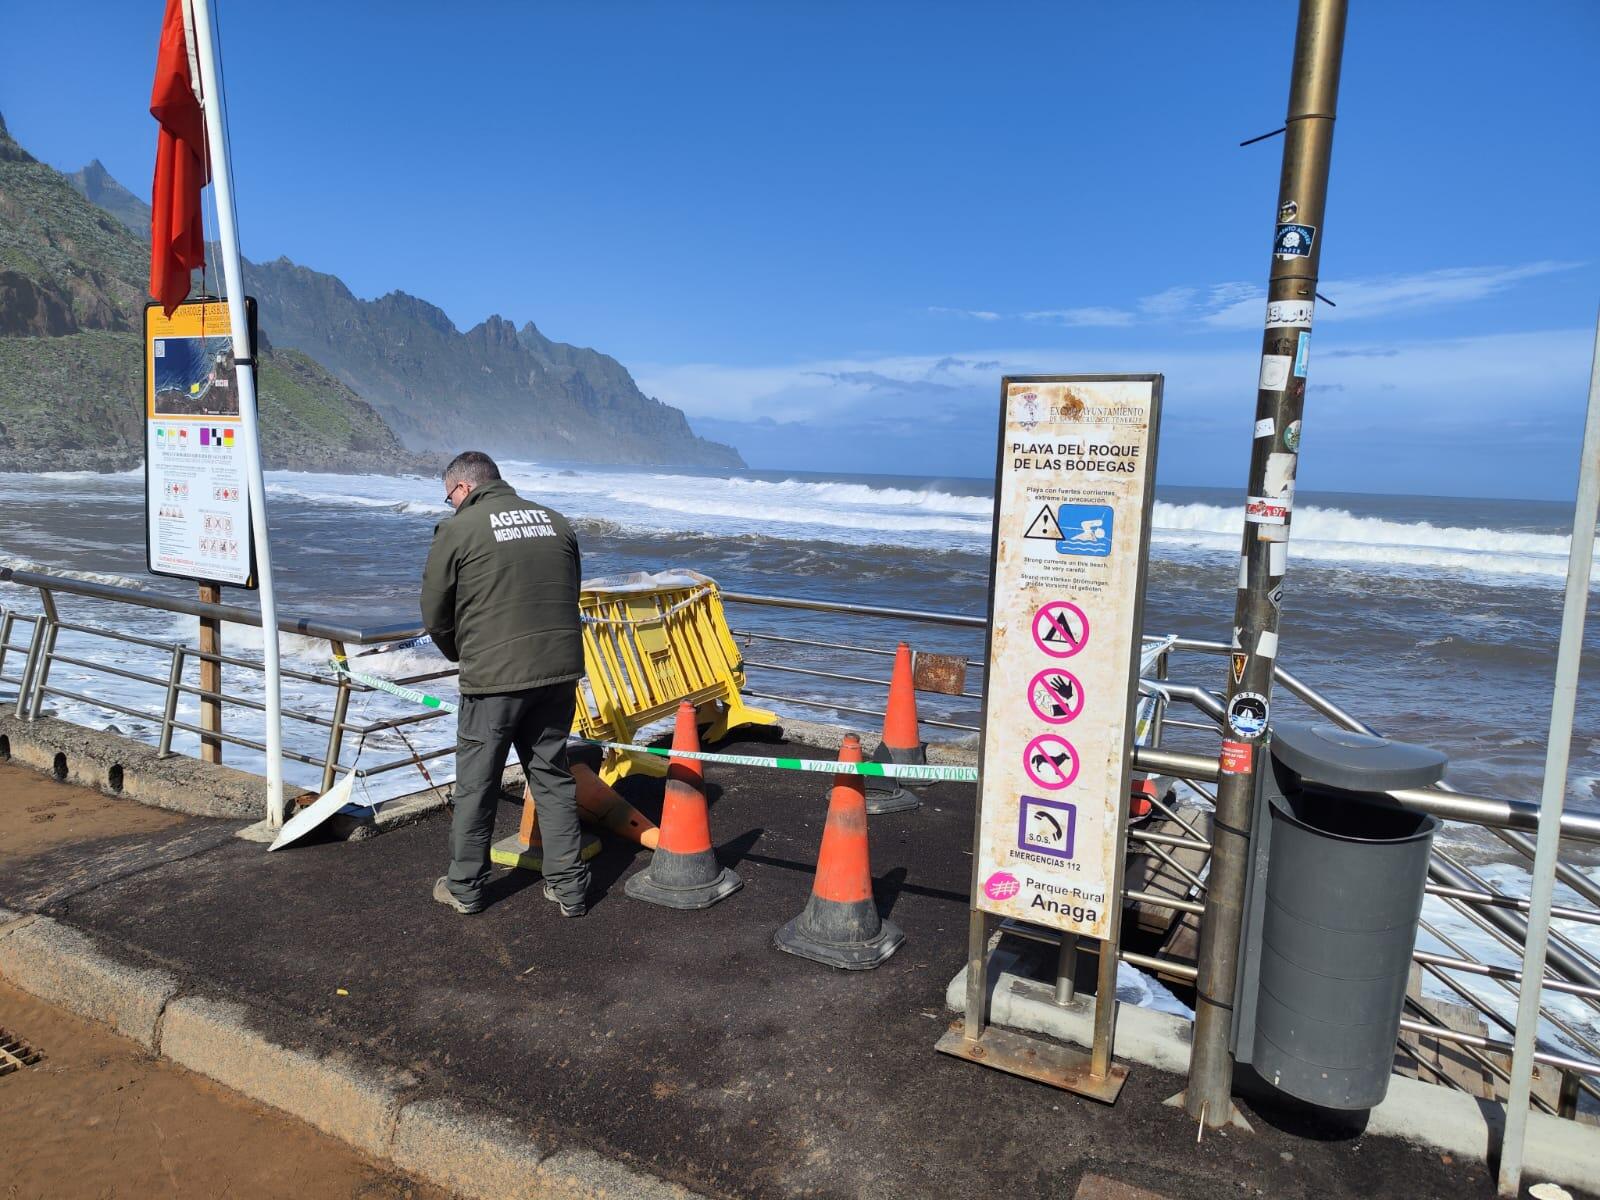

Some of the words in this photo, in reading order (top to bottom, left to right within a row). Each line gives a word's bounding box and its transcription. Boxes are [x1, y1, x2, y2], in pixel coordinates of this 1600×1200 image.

[1082, 406, 1144, 417] AYUNTAMIENTO
[1012, 443, 1053, 455] PLAYA
[1057, 444, 1084, 456] DEL
[1089, 445, 1139, 457] ROQUE
[1014, 459, 1031, 469] DE
[1035, 459, 1061, 470] LAS
[1066, 460, 1135, 472] BODEGAS
[490, 510, 551, 527] AGENTE
[493, 527, 522, 543] MEDIO
[521, 525, 556, 538] NATURAL
[1028, 832, 1051, 844] S.O.S.
[1010, 850, 1064, 867] EMERGENCIAS
[1067, 861, 1081, 872] 112
[1026, 877, 1069, 896] Parque
[1073, 887, 1105, 903] Rural
[1031, 894, 1097, 922] Anaga
